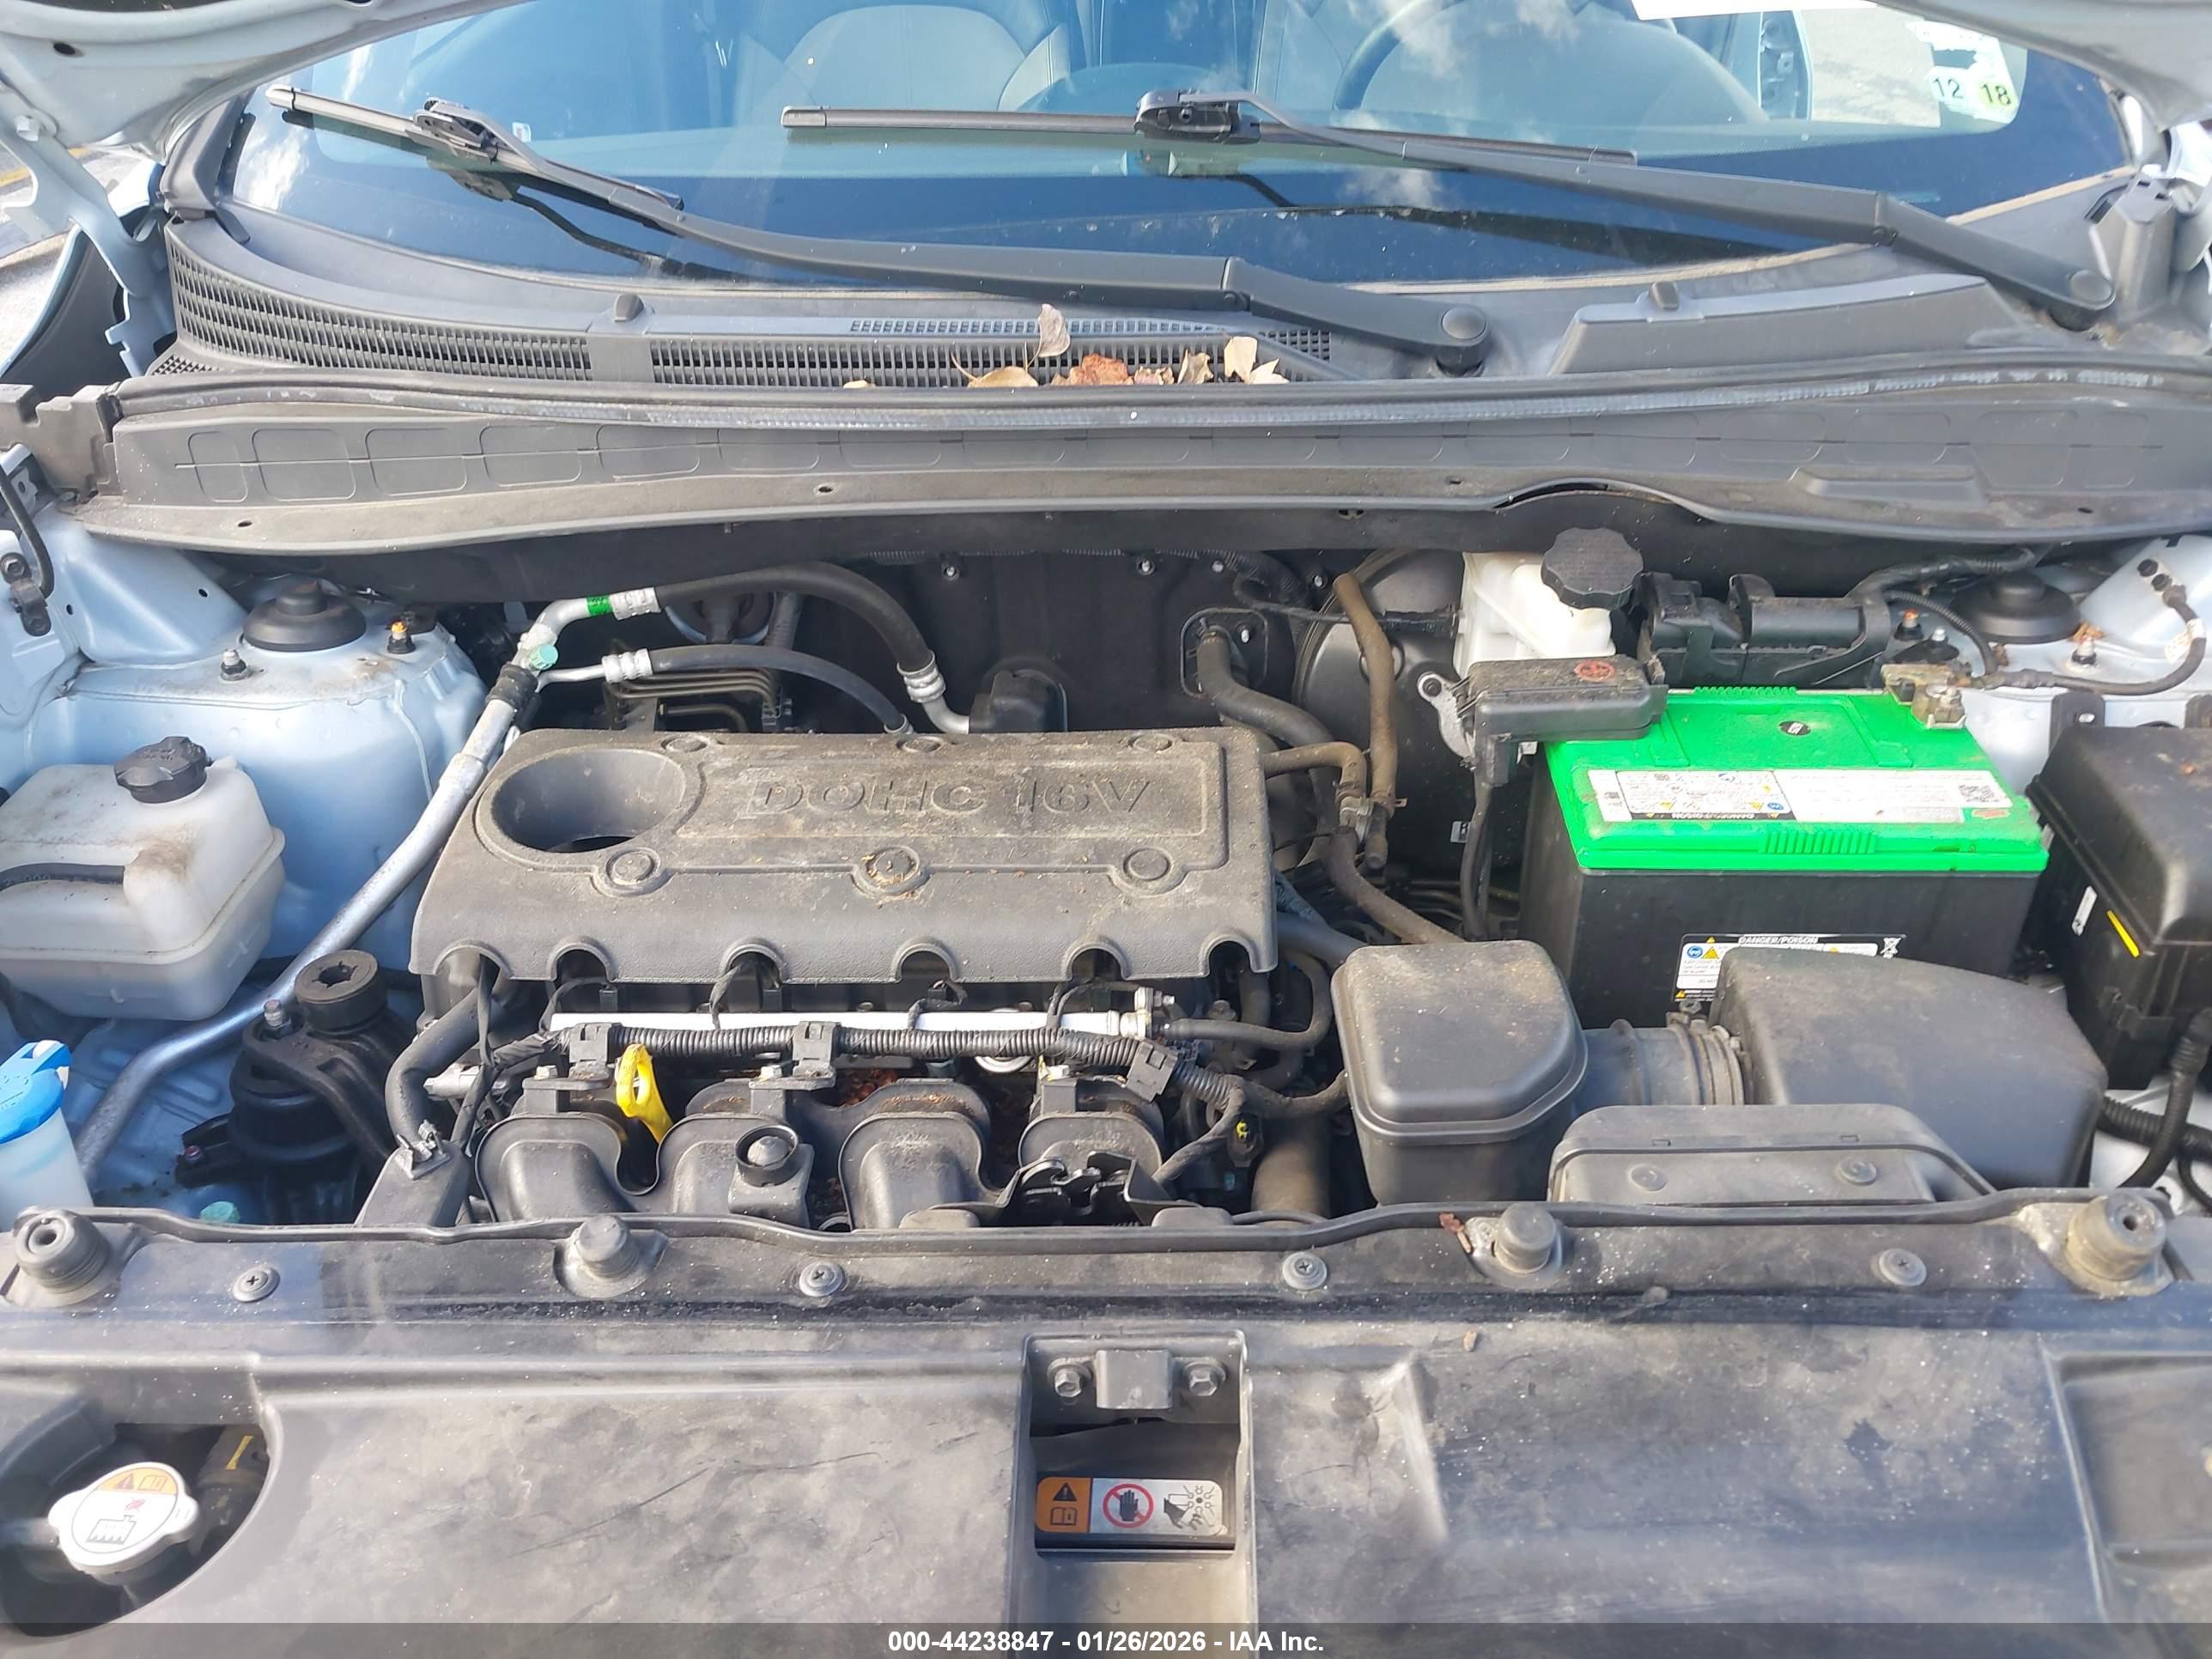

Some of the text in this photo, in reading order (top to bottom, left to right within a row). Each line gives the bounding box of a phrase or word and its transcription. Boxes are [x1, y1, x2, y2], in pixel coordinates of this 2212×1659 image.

[1932, 77, 1964, 99] 12
[1980, 83, 2012, 106] 18
[744, 779, 1151, 815] DOHC 16V
[1737, 935, 1819, 945] DANGER/POISON
